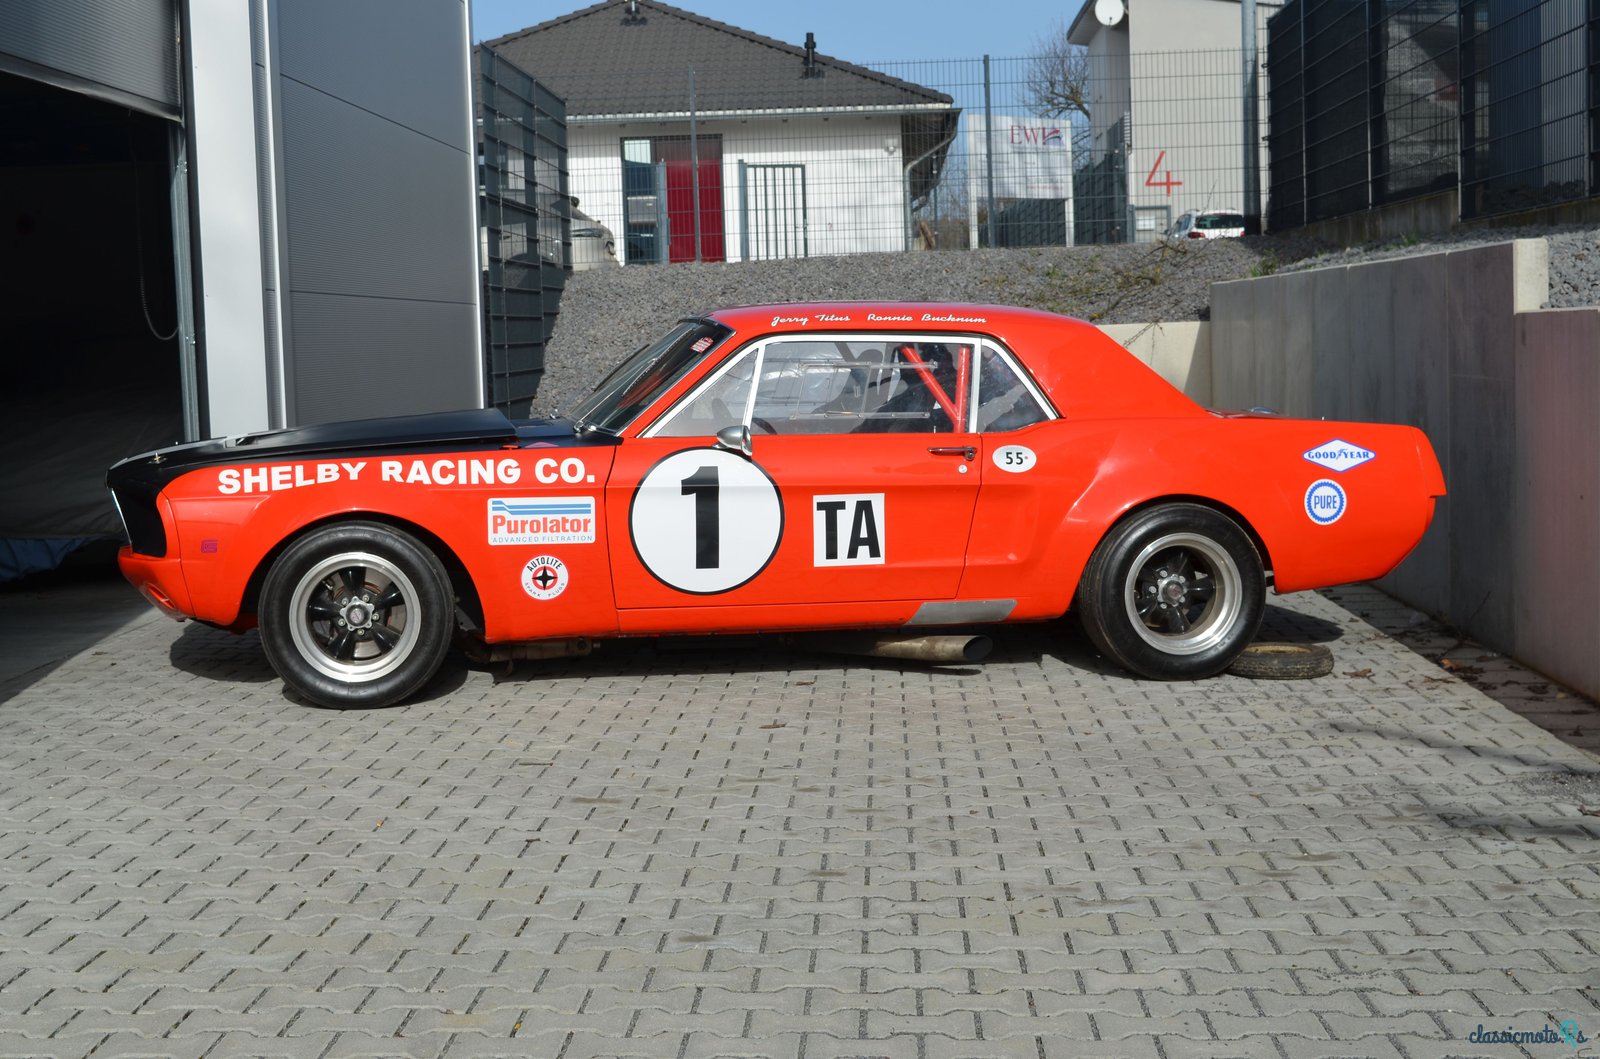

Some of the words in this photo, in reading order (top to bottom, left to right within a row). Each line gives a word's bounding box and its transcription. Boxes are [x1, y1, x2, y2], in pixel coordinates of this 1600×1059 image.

[1145, 150, 1183, 197] 4
[771, 316, 809, 327] Jerry
[814, 313, 850, 323] Titus
[867, 313, 913, 323] Ronnie
[921, 313, 987, 324] Bucknum
[217, 461, 368, 495] SHELBY
[380, 458, 521, 485] RACING
[534, 457, 595, 484] CO.
[1313, 494, 1338, 510] PURE
[491, 514, 592, 535] Purolator
[681, 465, 720, 570] 1
[816, 499, 882, 561] TA
[492, 536, 540, 544] ADVANCED
[542, 535, 593, 543] FILTRATION
[526, 556, 563, 573] AUTOLITE
[525, 582, 541, 598] SPARK
[547, 582, 565, 598] PLUGS
